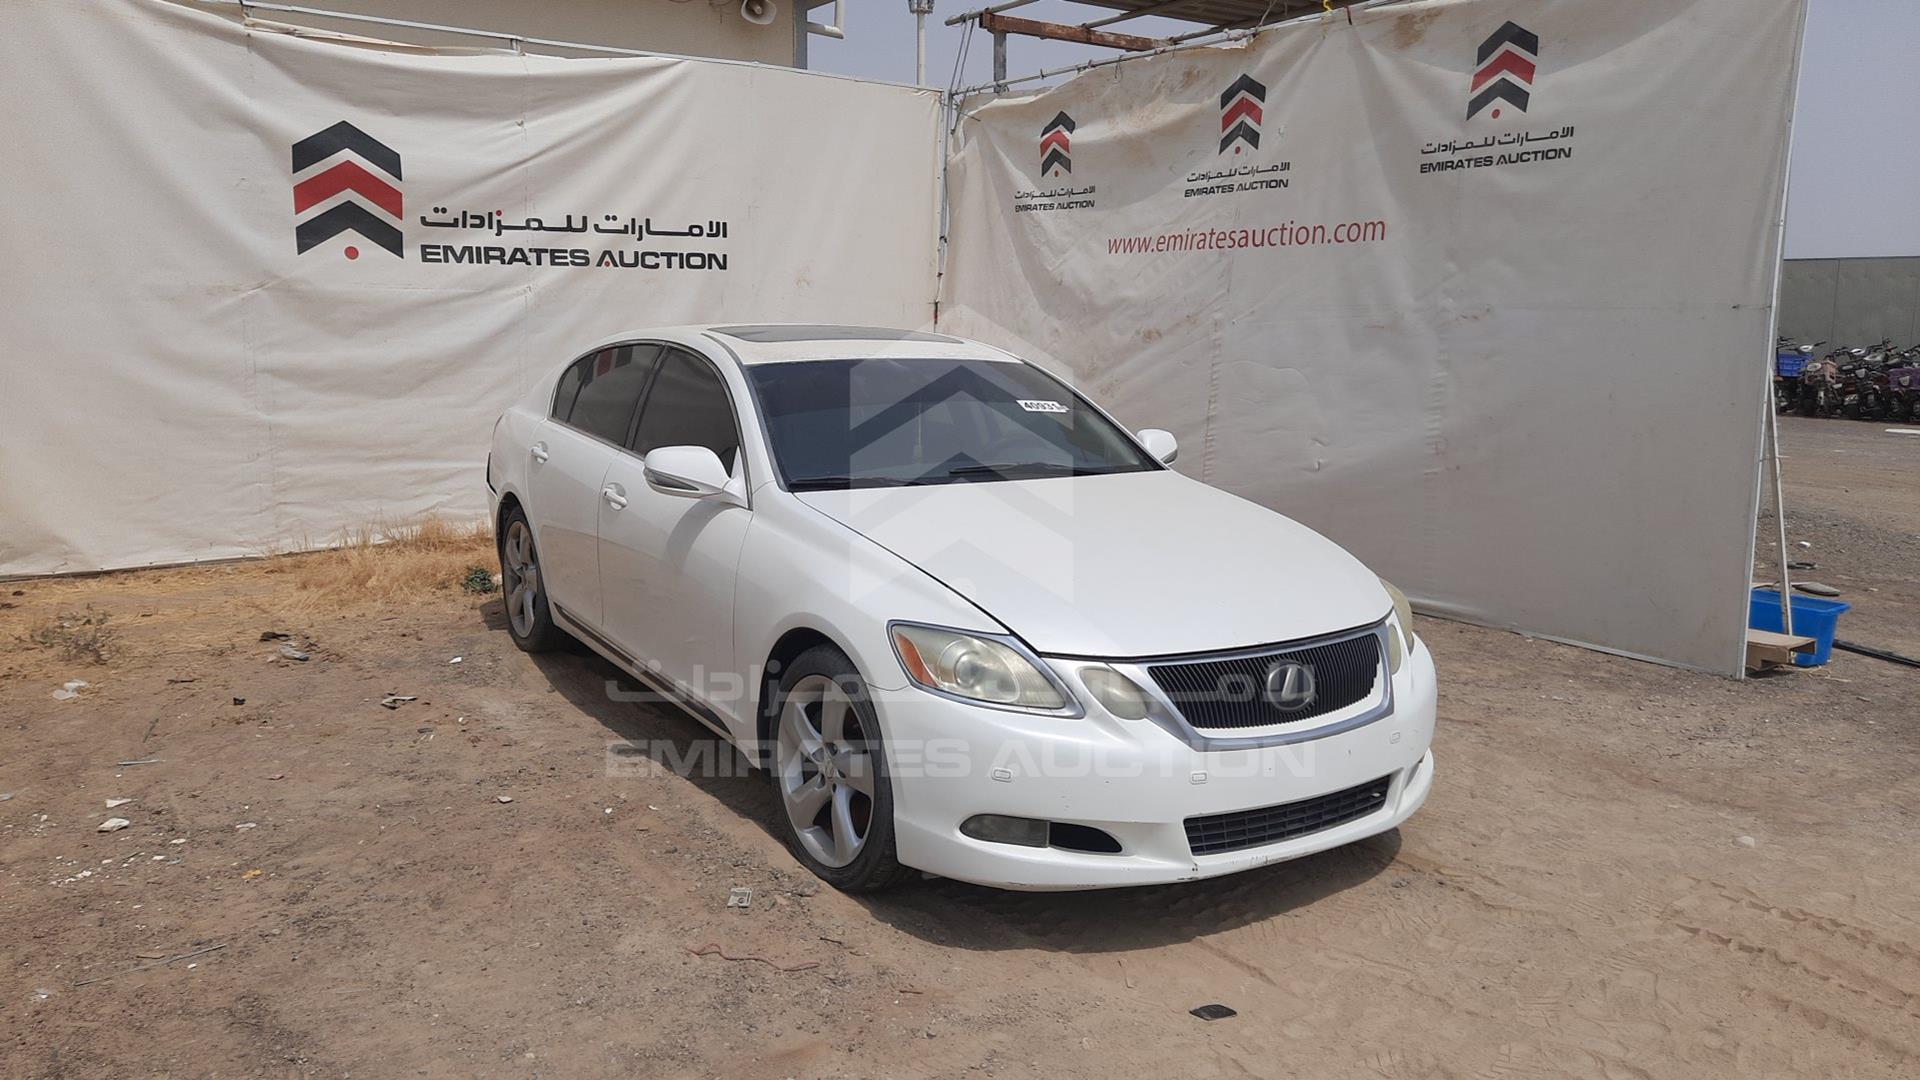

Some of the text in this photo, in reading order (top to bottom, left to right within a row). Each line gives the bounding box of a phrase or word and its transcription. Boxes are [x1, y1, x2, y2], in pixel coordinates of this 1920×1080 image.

[1419, 147, 1573, 174] EMIRATES AUCTION
[1183, 178, 1290, 198] EMIRATES AUCTION
[1014, 199, 1096, 213] EMIRATES AUCTION
[1107, 220, 1387, 254] www.emiratesauction.com
[420, 244, 728, 270] EMIRATES AUCTION
